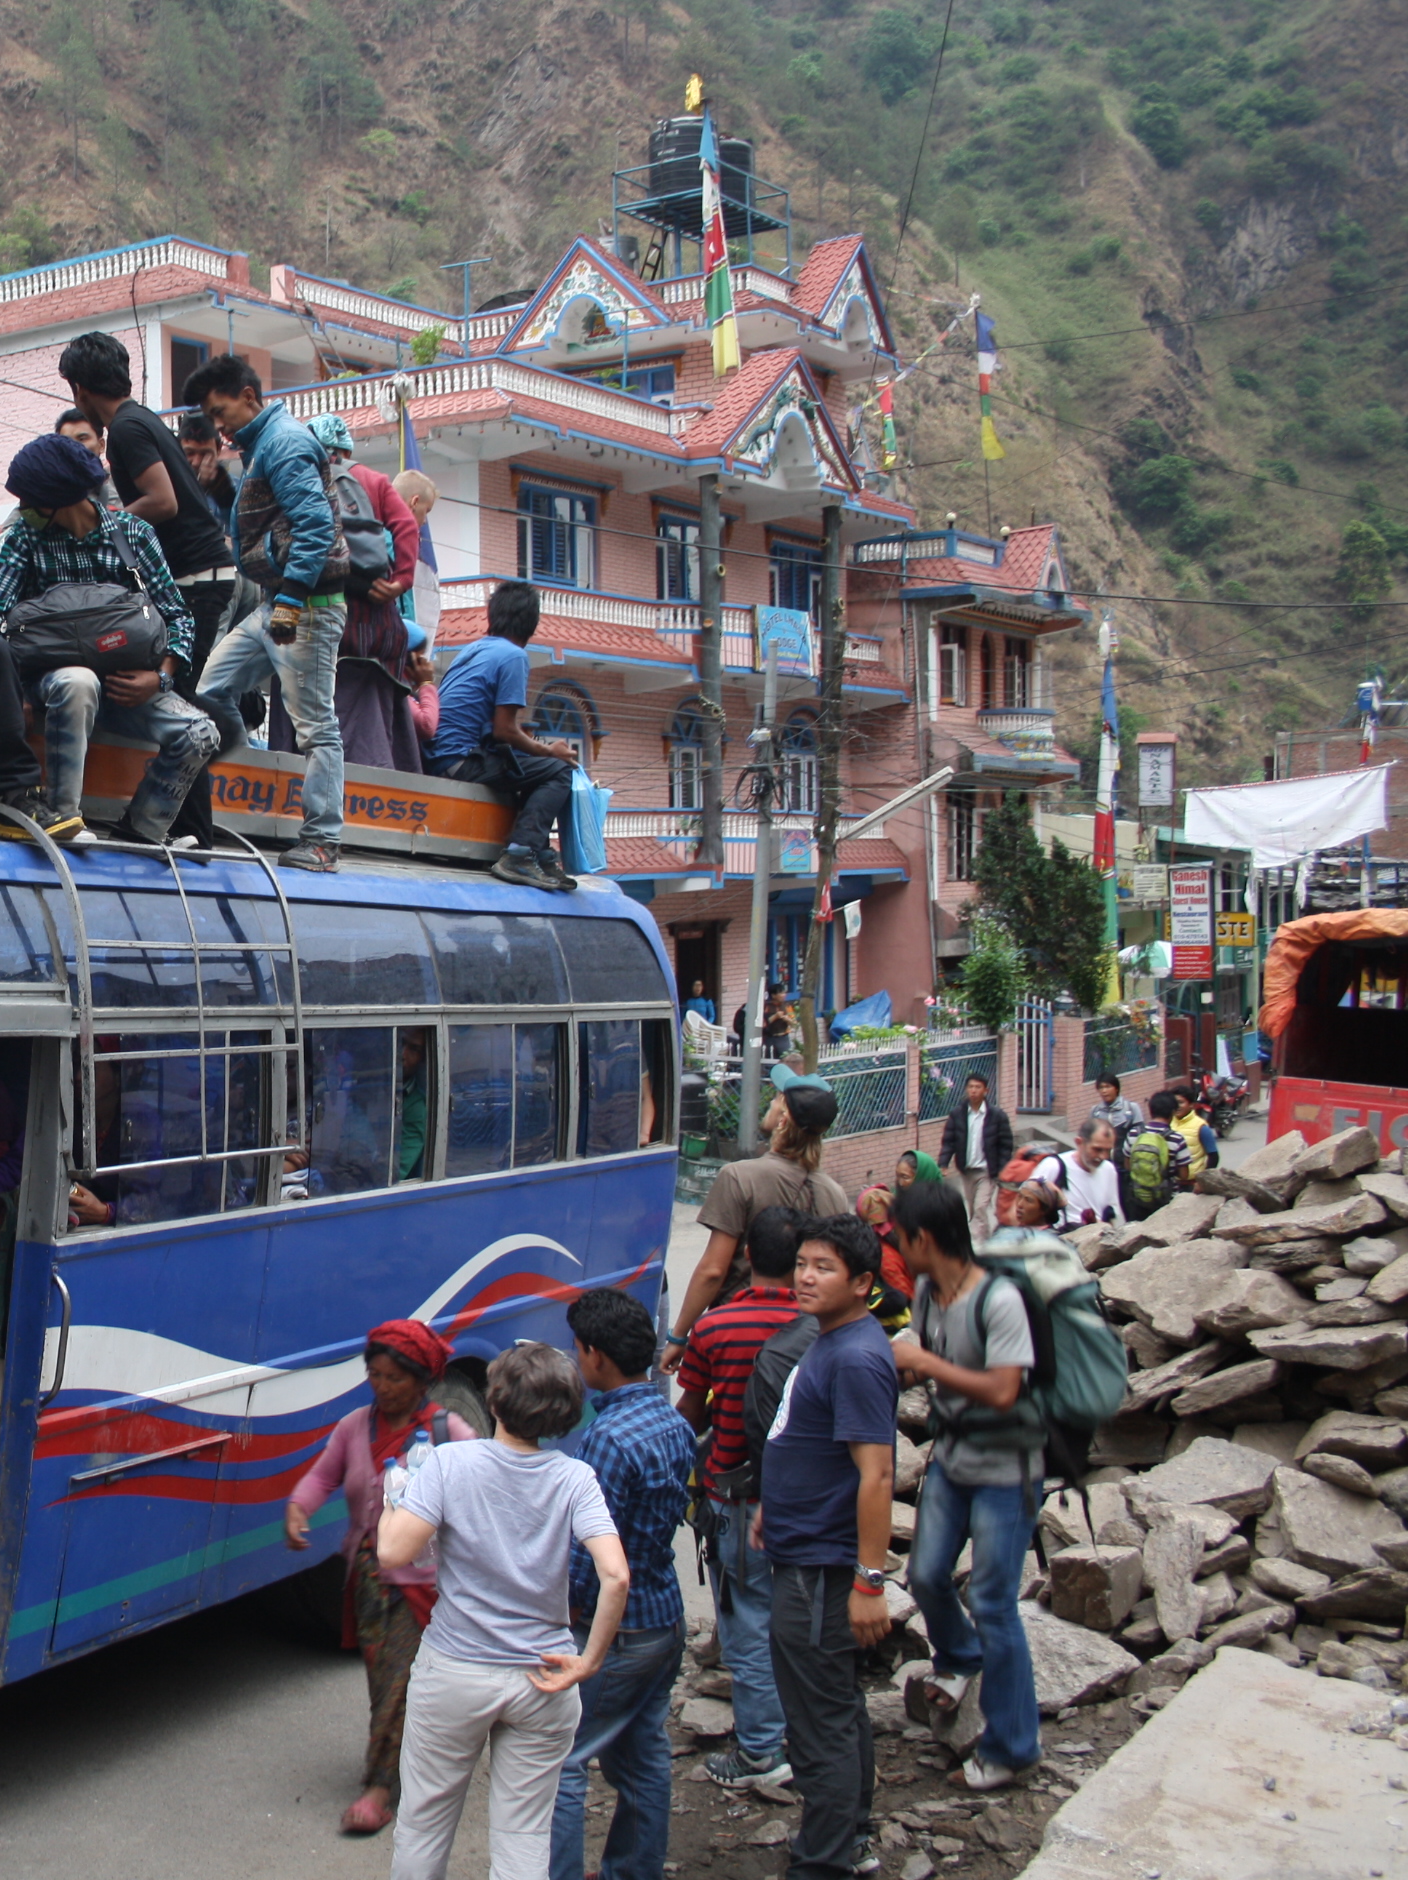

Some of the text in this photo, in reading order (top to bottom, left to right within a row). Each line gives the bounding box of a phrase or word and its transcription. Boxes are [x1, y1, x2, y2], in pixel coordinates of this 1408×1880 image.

[1172, 870, 1207, 881] Ganesh
[1174, 883, 1206, 895] Himal
[1217, 921, 1248, 936] STE
